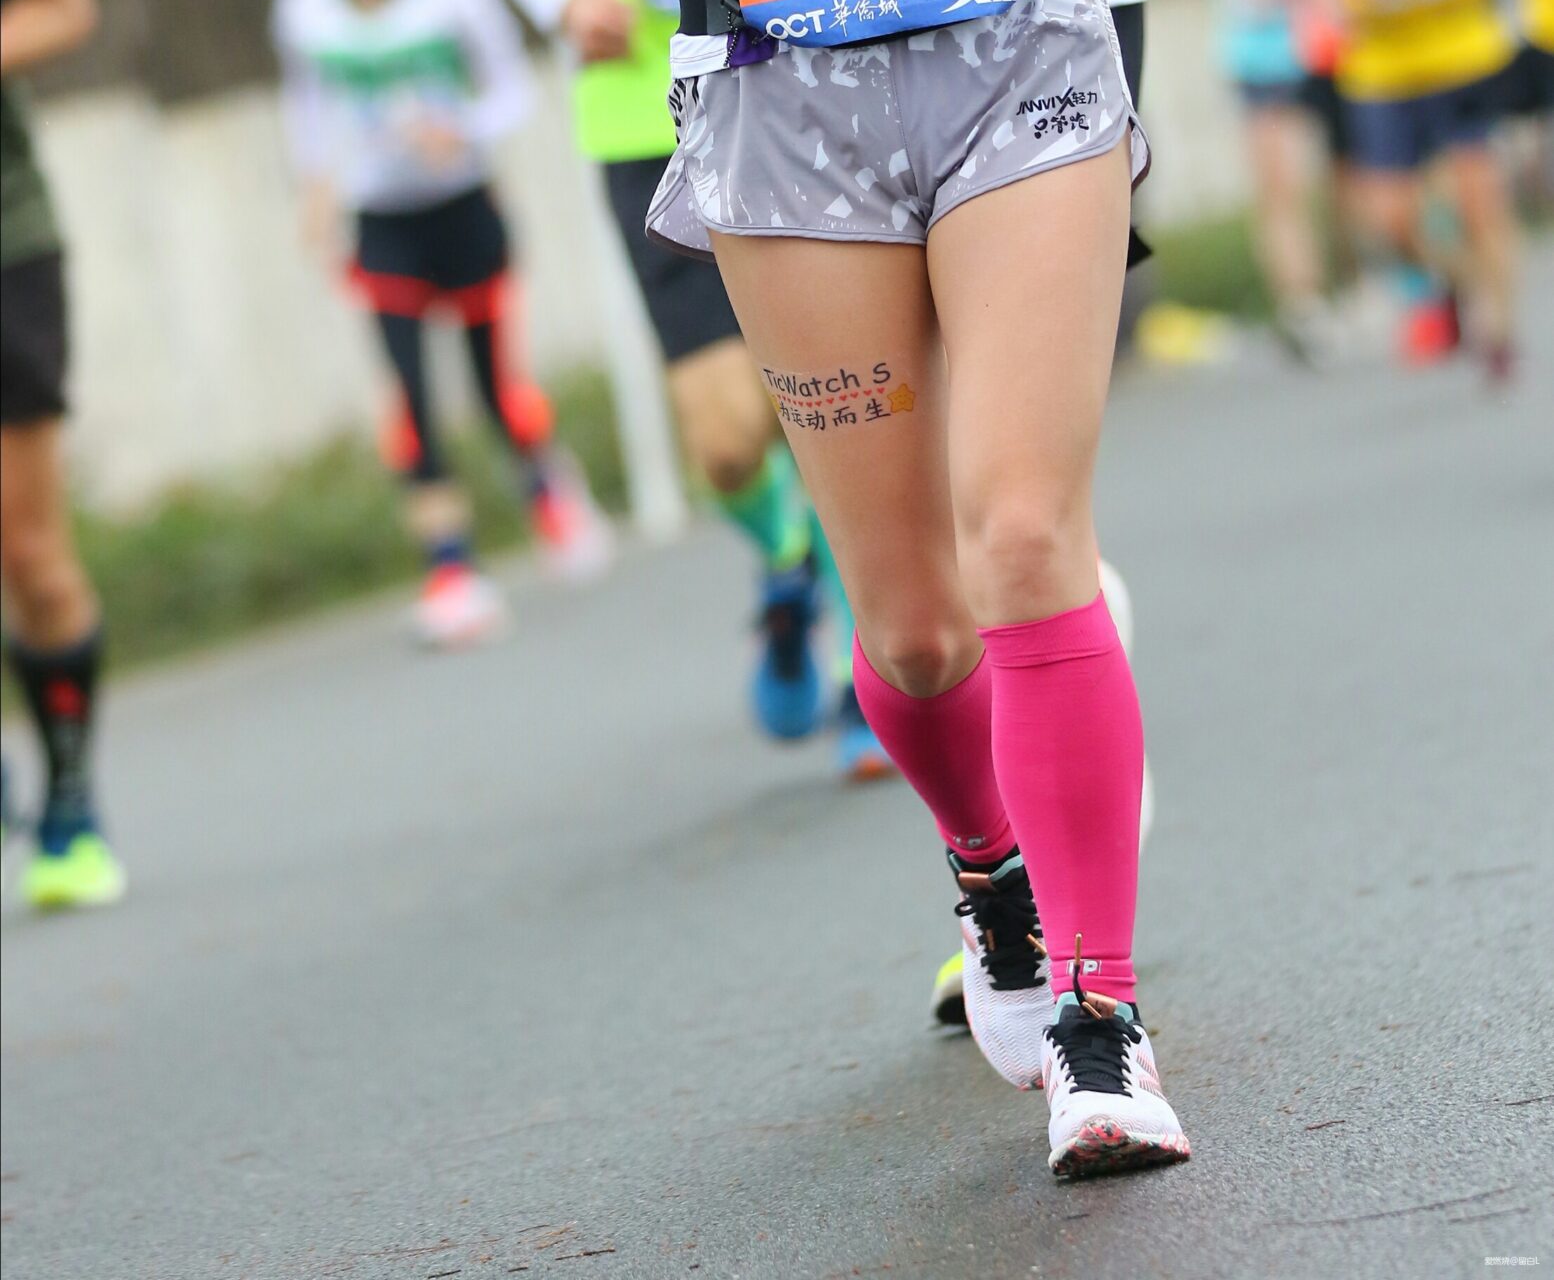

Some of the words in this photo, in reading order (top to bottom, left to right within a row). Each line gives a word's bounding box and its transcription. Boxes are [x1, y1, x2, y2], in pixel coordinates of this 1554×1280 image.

[1071, 91, 1098, 104] 轻力
[763, 368, 860, 397] TicWatch
[873, 362, 891, 384] S
[780, 398, 891, 431] 为运动而生
